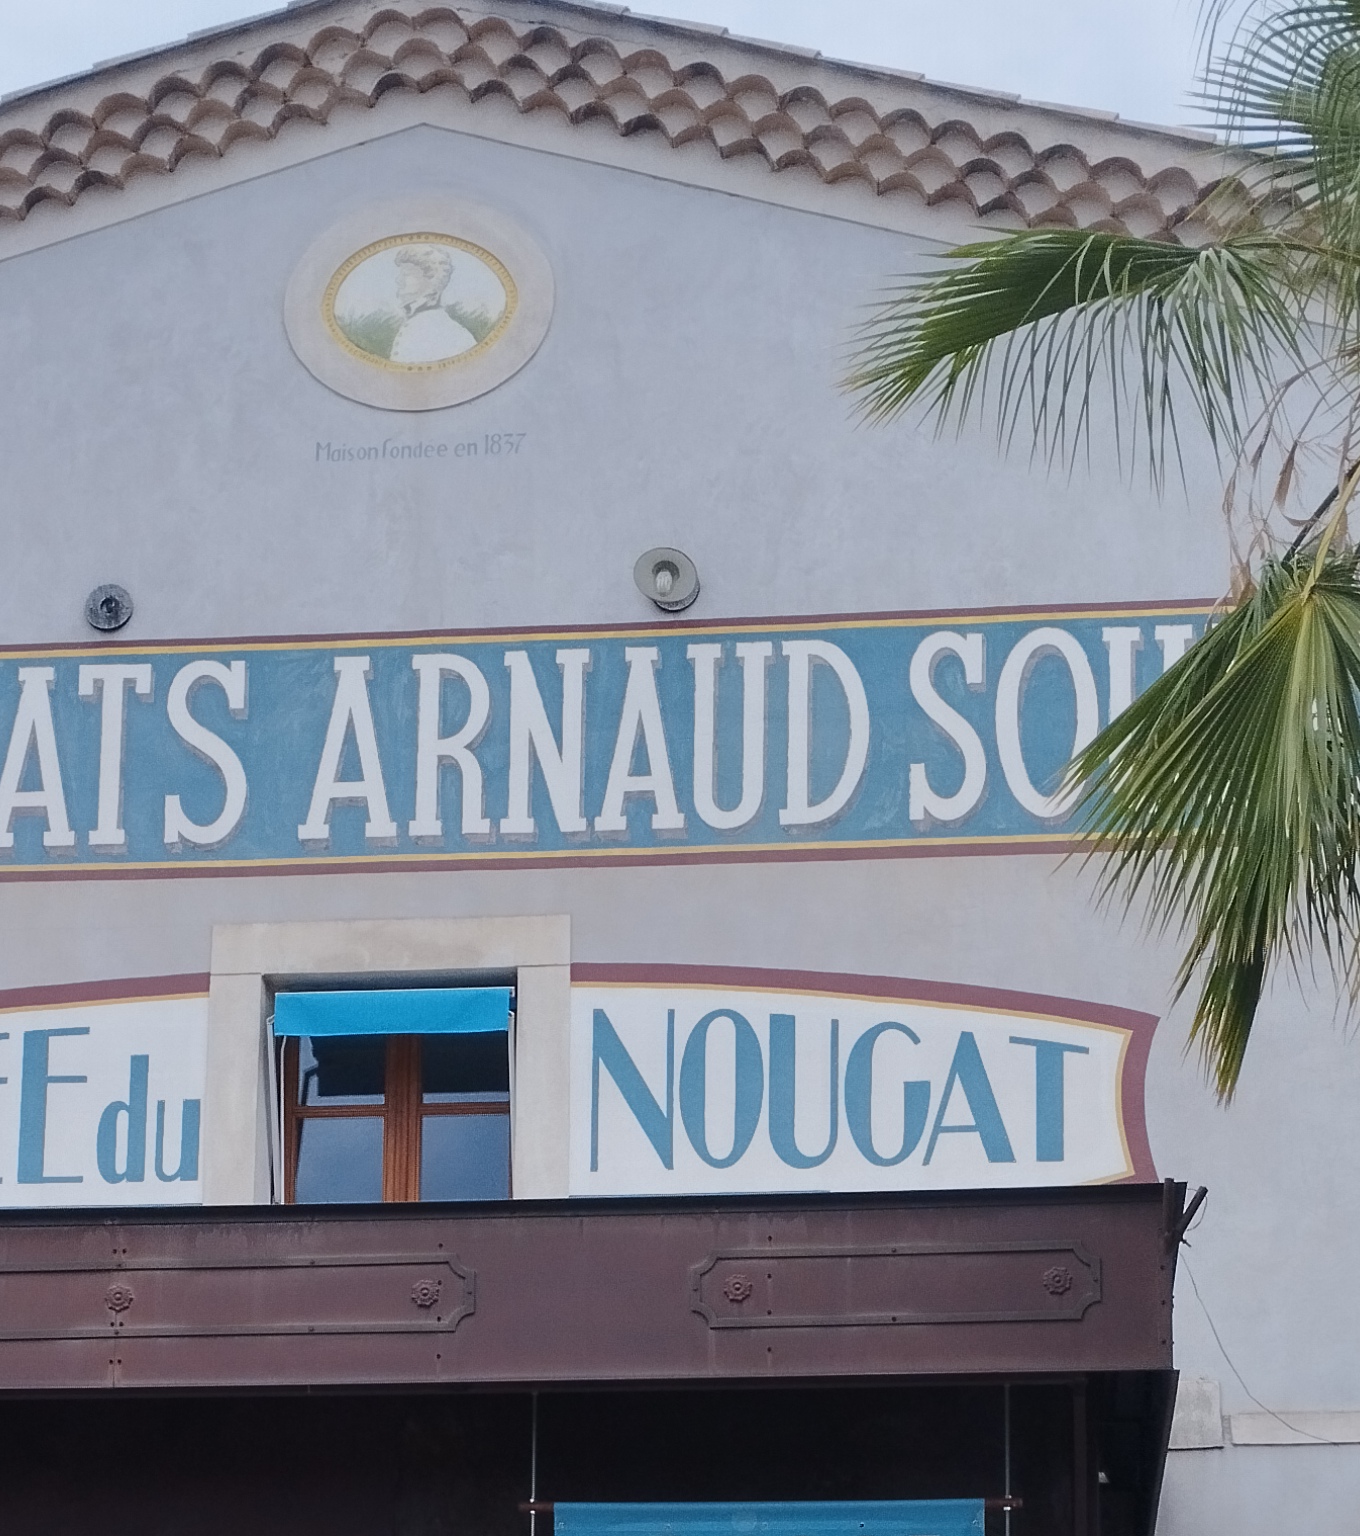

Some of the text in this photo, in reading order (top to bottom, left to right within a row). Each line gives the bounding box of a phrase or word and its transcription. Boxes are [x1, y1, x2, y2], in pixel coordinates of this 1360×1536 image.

[316, 441, 378, 462] Maison
[454, 441, 478, 458] en
[484, 432, 527, 456] 1837
[297, 639, 870, 844] ARNAUD
[97, 1054, 201, 1184] du
[590, 1008, 1090, 1172] NOUGAT
